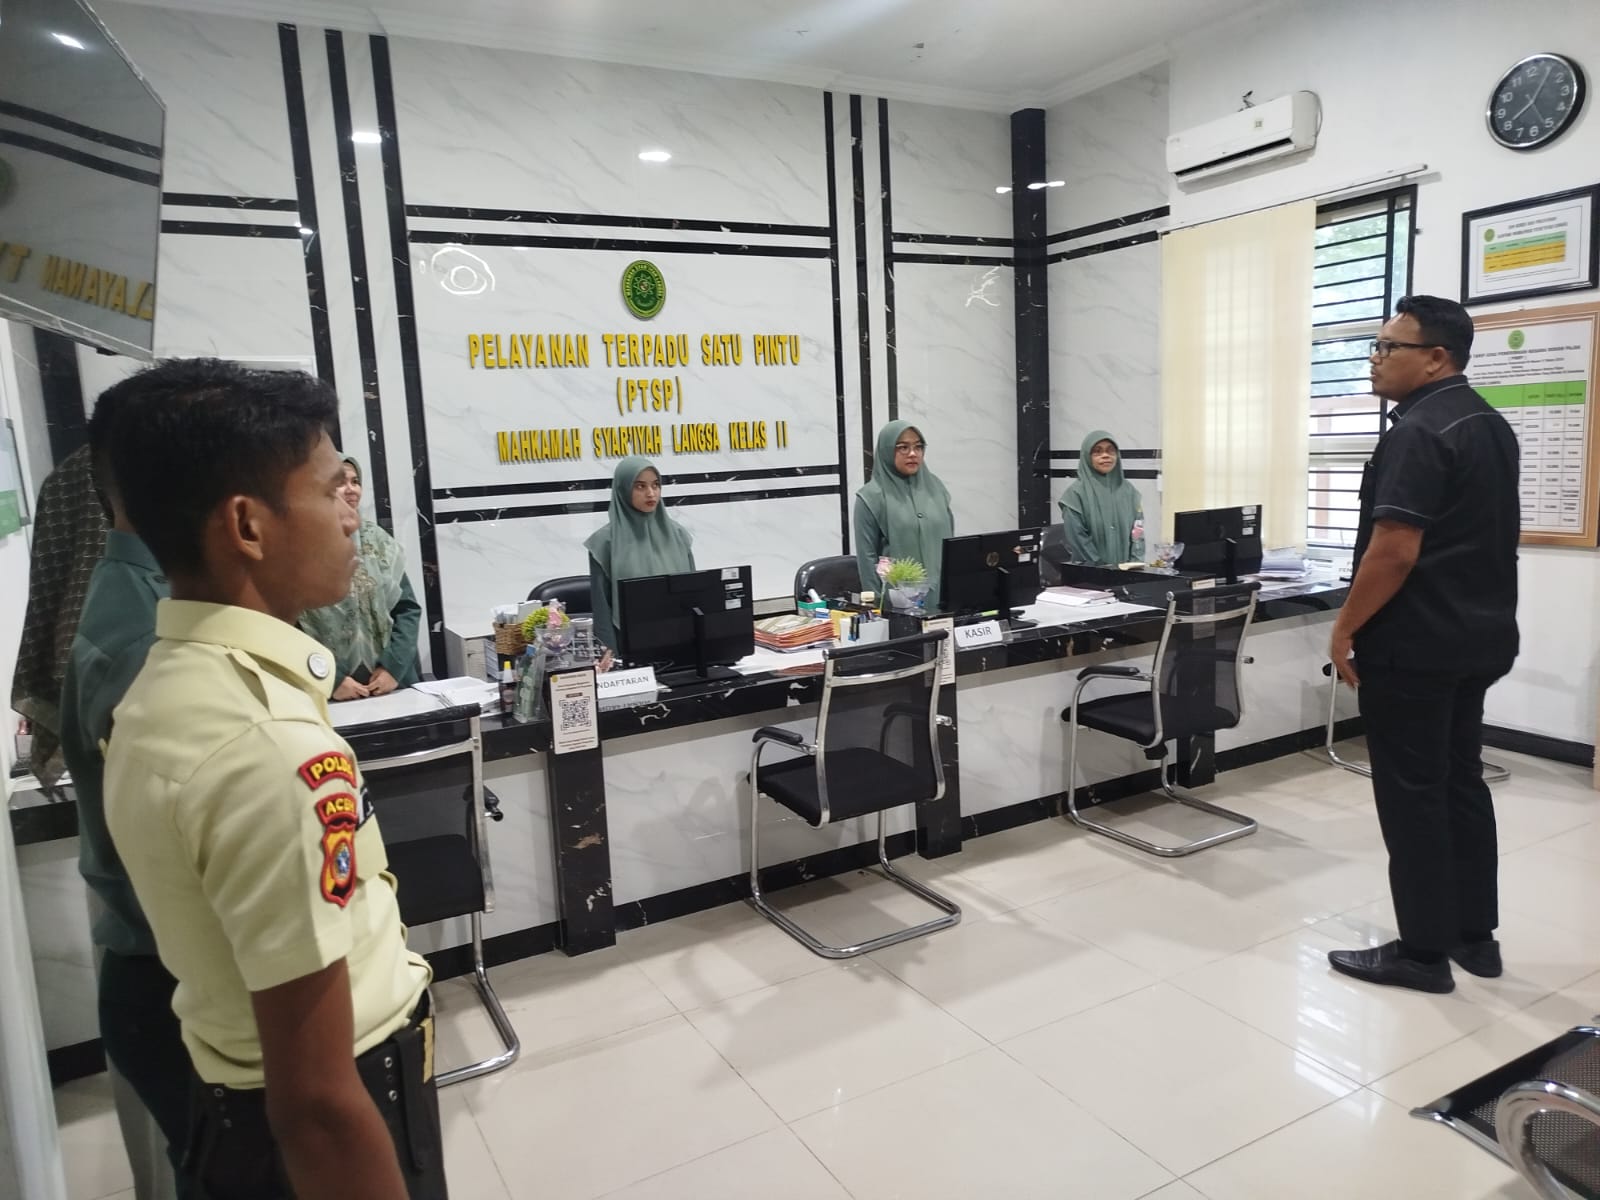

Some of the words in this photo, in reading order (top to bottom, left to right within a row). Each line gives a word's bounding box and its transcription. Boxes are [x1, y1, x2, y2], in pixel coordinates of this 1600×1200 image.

[1526, 66, 1537, 77] 12
[1512, 76, 1522, 87] 11
[1555, 72, 1564, 83] 2
[1560, 85, 1569, 96] 3
[1501, 92, 1513, 103] 10
[1498, 108, 1506, 119] 9
[1545, 118, 1554, 128] 5
[1516, 127, 1524, 138] 7
[1529, 126, 1539, 137] 6
[468, 333, 590, 369] PELAYANAN
[602, 333, 689, 368] TERPADU
[701, 333, 743, 366] SATU
[753, 334, 800, 366] PINTU
[616, 376, 683, 416] (PTSP)
[496, 428, 583, 463] MAHKAMAH
[672, 422, 721, 454] LANGSA
[728, 420, 767, 450] KELAS
[776, 420, 788, 448] II
[964, 626, 992, 639] KASIR
[598, 676, 649, 689] NDAFTARAN
